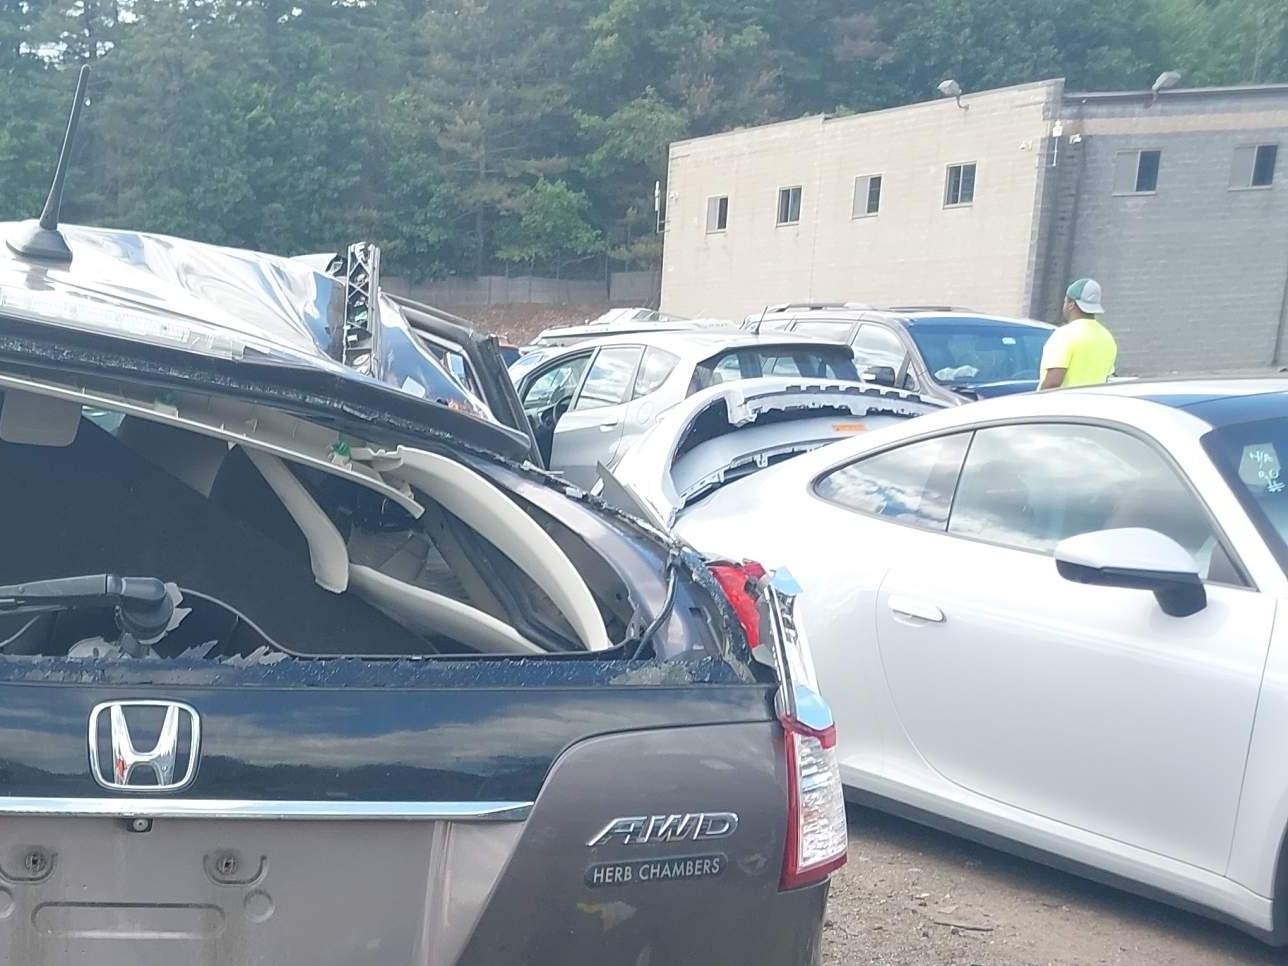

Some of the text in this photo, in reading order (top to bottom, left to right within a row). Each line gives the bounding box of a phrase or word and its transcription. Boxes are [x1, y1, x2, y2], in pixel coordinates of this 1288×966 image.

[585, 812, 740, 847] AWD
[592, 857, 721, 884] HERB CHAMBERS
